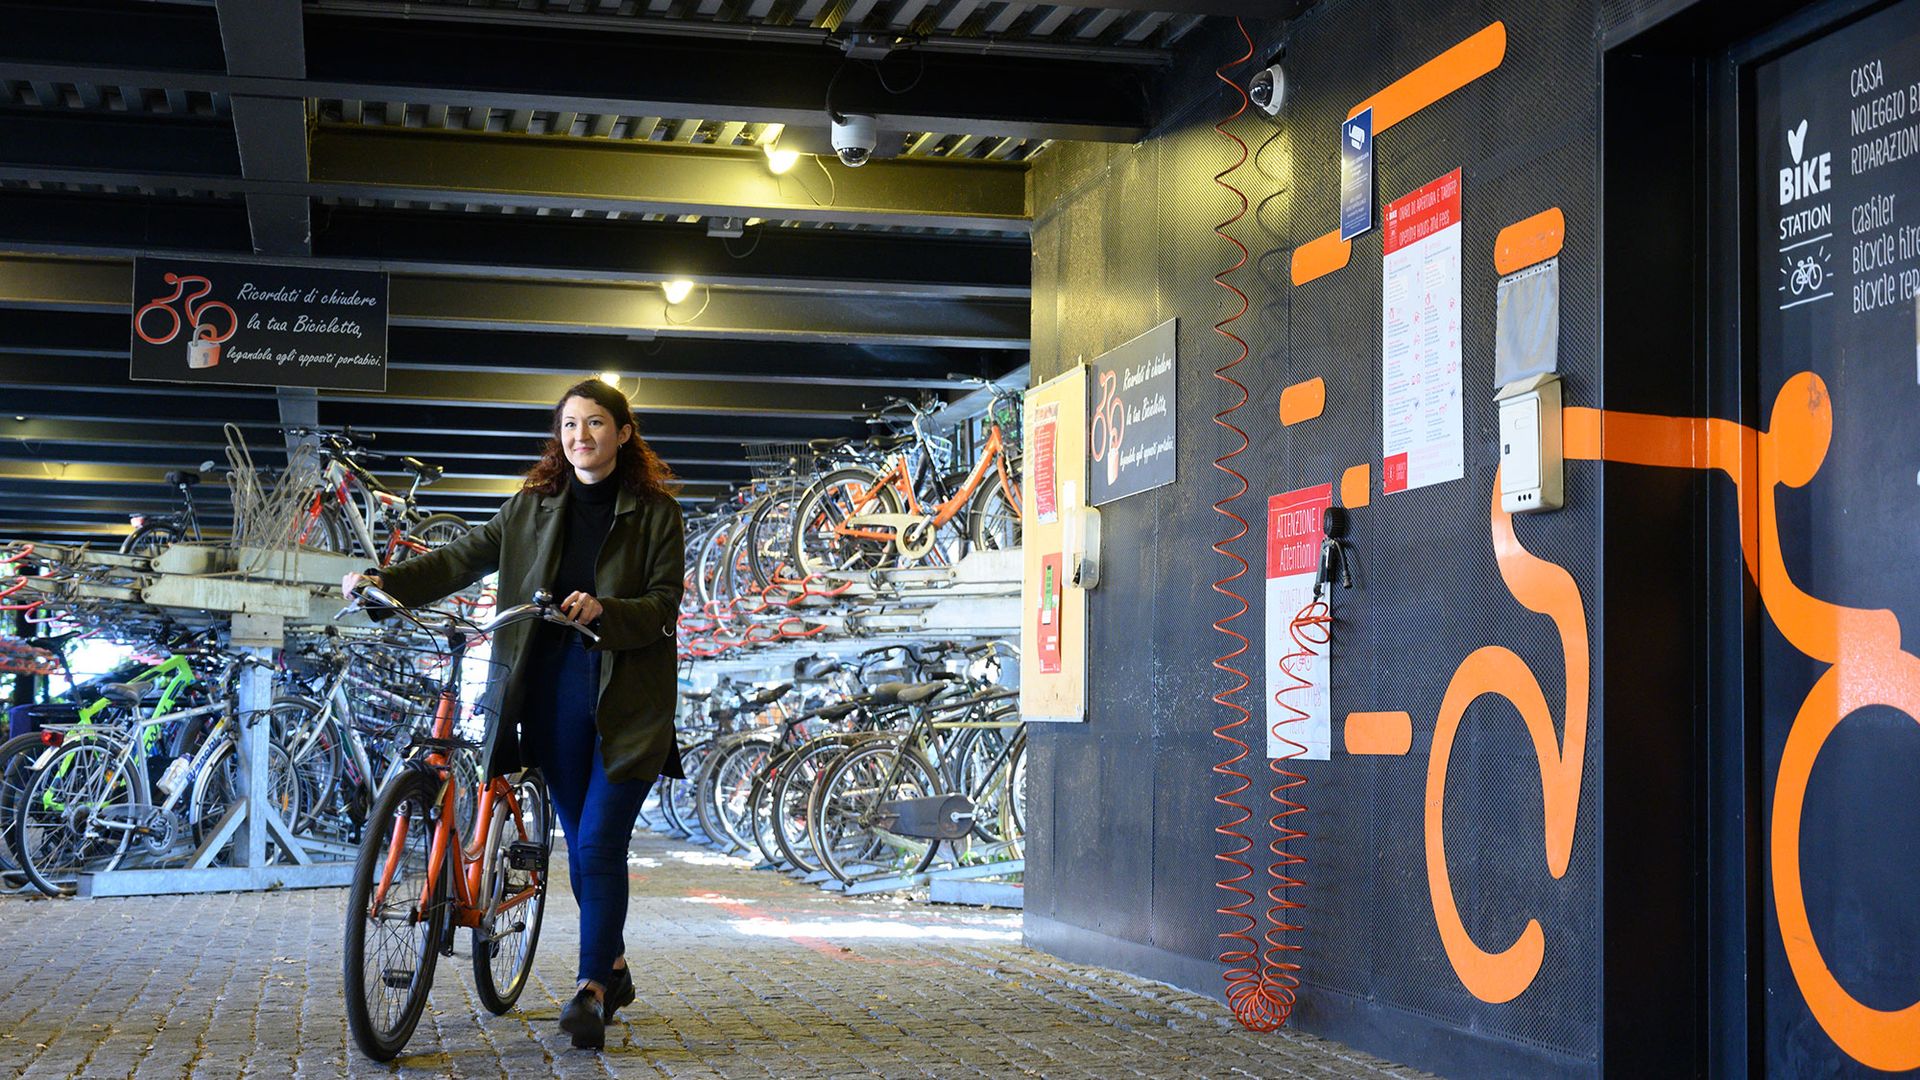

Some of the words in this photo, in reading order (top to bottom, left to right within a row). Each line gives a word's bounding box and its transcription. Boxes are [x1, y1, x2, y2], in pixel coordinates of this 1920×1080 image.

[1851, 59, 1883, 98] CASSA
[1851, 89, 1905, 137] NOLEGGIO
[1851, 123, 1920, 175] RIPARAZION
[1779, 152, 1832, 206] BIKE
[1779, 203, 1832, 240] STATION
[1852, 232, 1895, 275] Bicycle
[236, 283, 302, 303] Ricordati
[303, 288, 319, 304] di
[321, 289, 377, 307] chiudere
[1853, 272, 1896, 314] Bicycle
[247, 313, 261, 330] la
[267, 317, 288, 331] tua
[293, 315, 362, 338] Bicicletta,
[226, 346, 272, 364] legandola
[276, 349, 297, 366] agli
[298, 353, 337, 368] appositi
[334, 353, 381, 369] portabici.
[1276, 508, 1316, 539] ATTENZIONE
